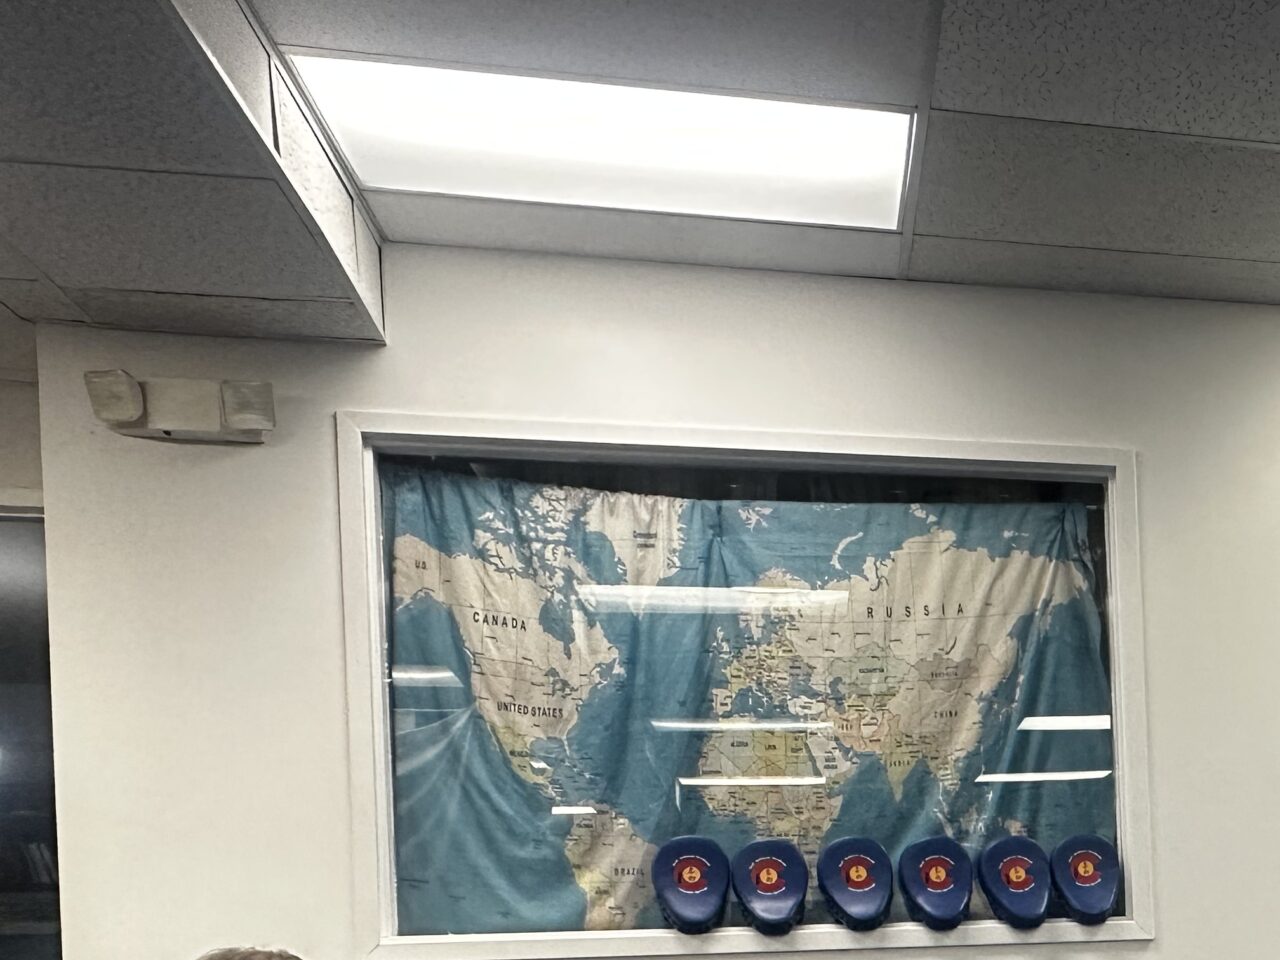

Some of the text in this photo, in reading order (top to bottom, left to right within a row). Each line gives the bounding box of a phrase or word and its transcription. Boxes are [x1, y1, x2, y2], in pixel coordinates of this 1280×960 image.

[867, 603, 964, 619] RUSSIA
[472, 611, 527, 632] CANADA
[497, 701, 564, 719] UNITED STATES
